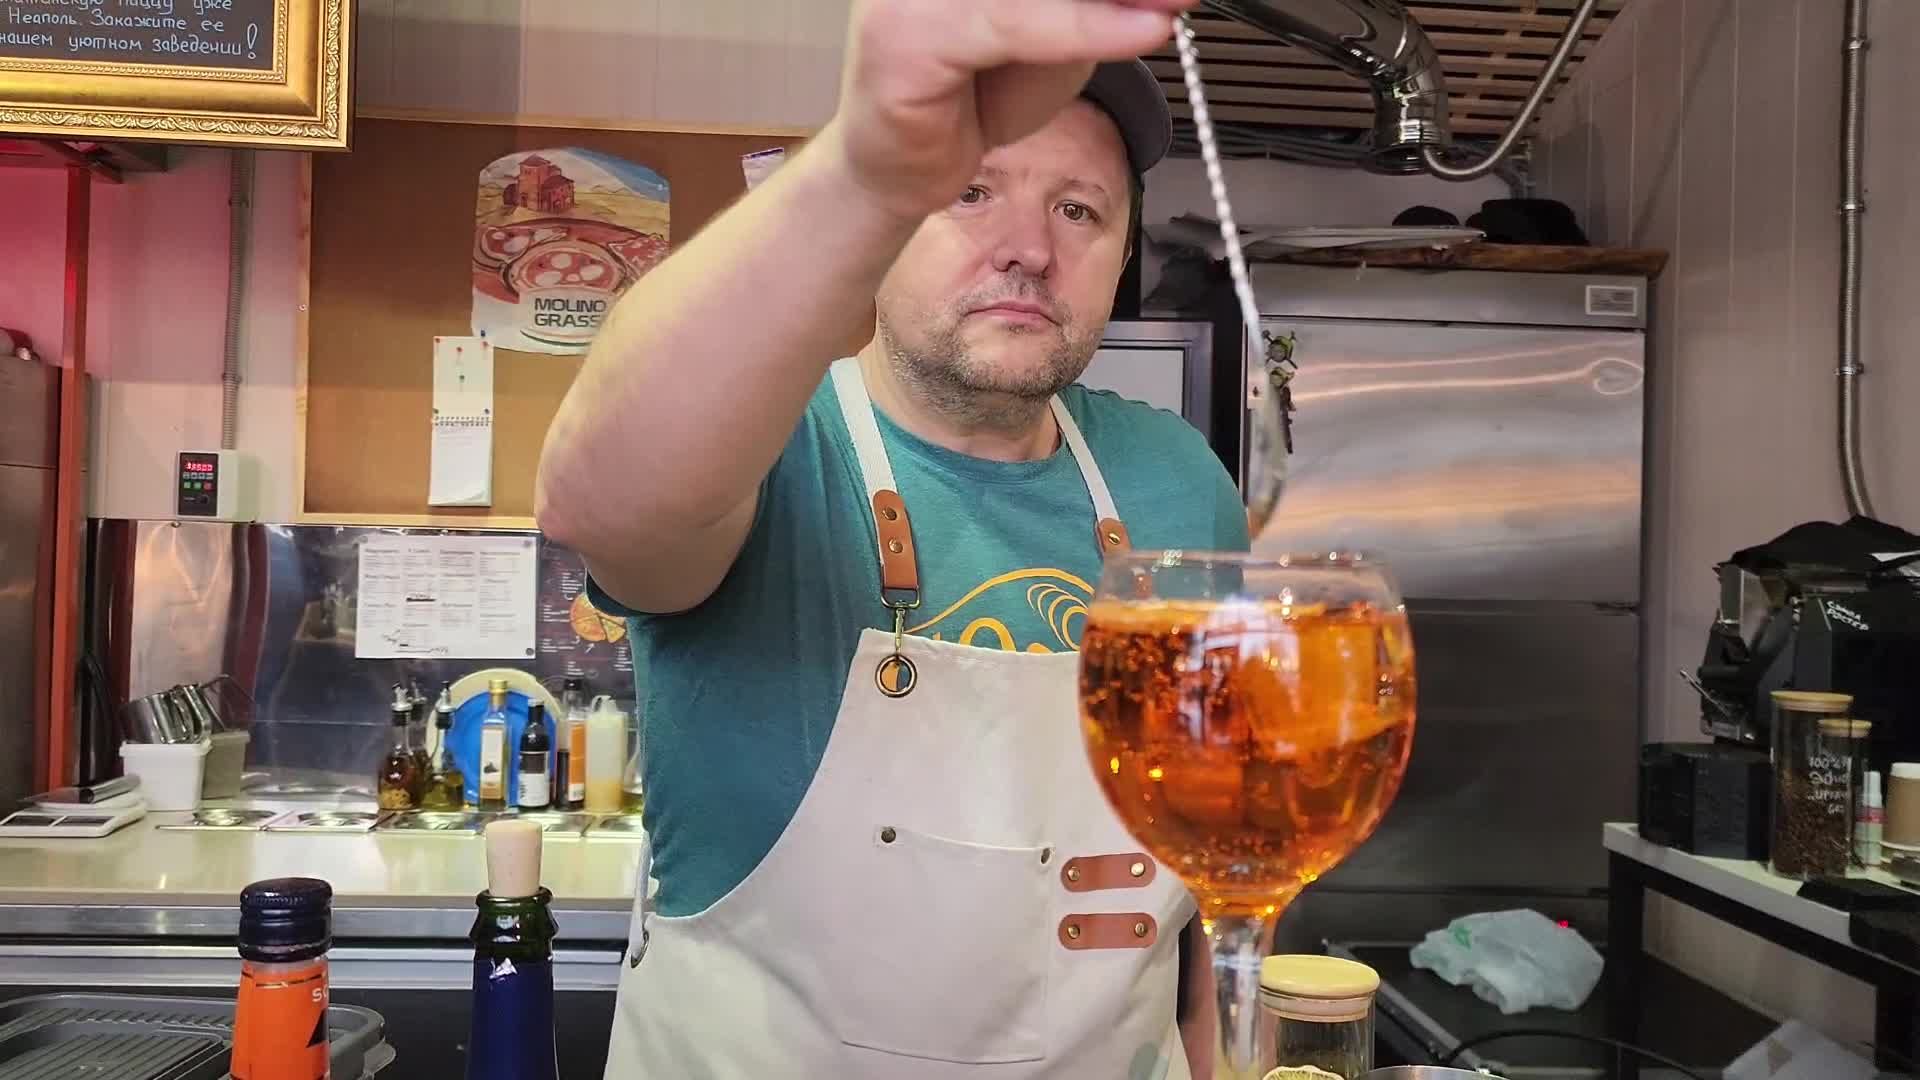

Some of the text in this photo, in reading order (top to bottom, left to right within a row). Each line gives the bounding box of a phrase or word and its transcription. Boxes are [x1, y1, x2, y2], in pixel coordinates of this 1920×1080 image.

[193, 0, 232, 15] уже
[90, 8, 188, 30] Закажите
[200, 20, 225, 32] ее
[68, 36, 142, 52] уютном
[534, 297, 607, 313] MOLINO
